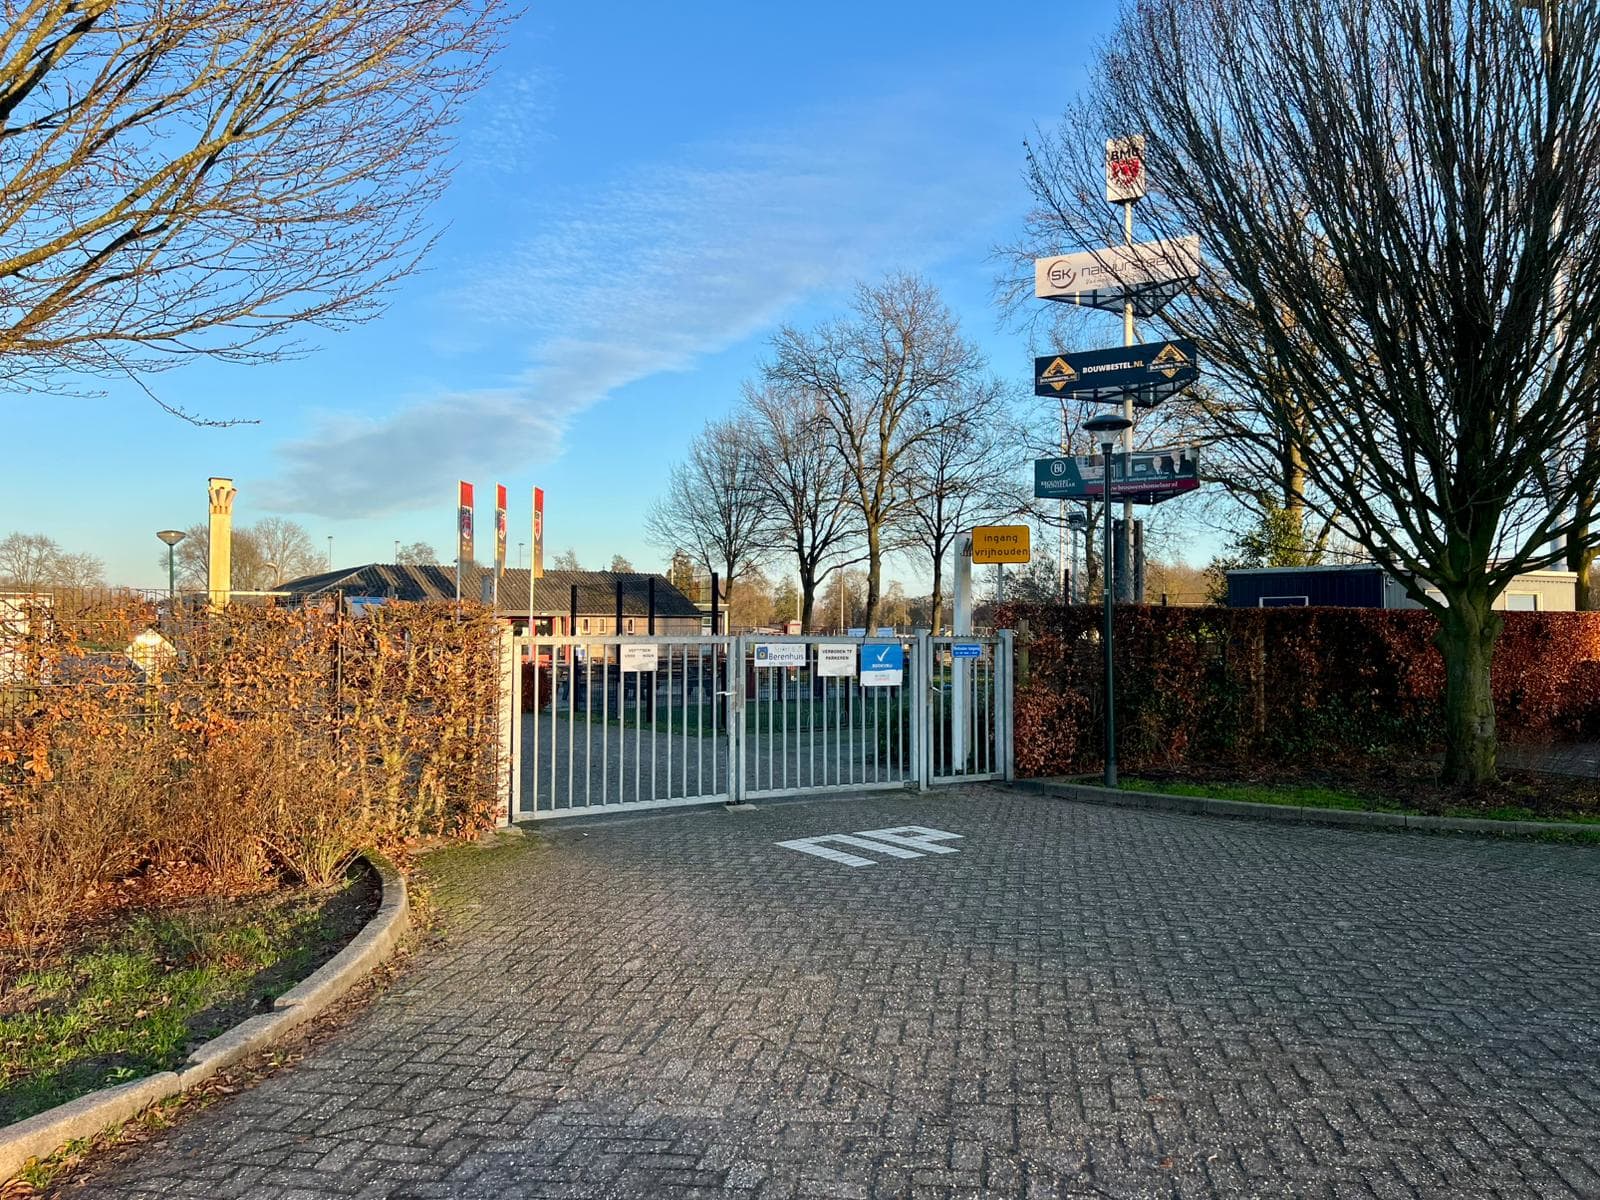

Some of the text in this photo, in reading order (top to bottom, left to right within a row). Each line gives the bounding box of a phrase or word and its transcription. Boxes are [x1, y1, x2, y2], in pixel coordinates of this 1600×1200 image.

[1051, 268, 1071, 280] SK
[1082, 360, 1144, 374] BOUWBESTEL.NL
[984, 535, 1018, 544] ingang
[975, 548, 1028, 558] vrijhouden
[769, 652, 804, 660] Berenhuis
